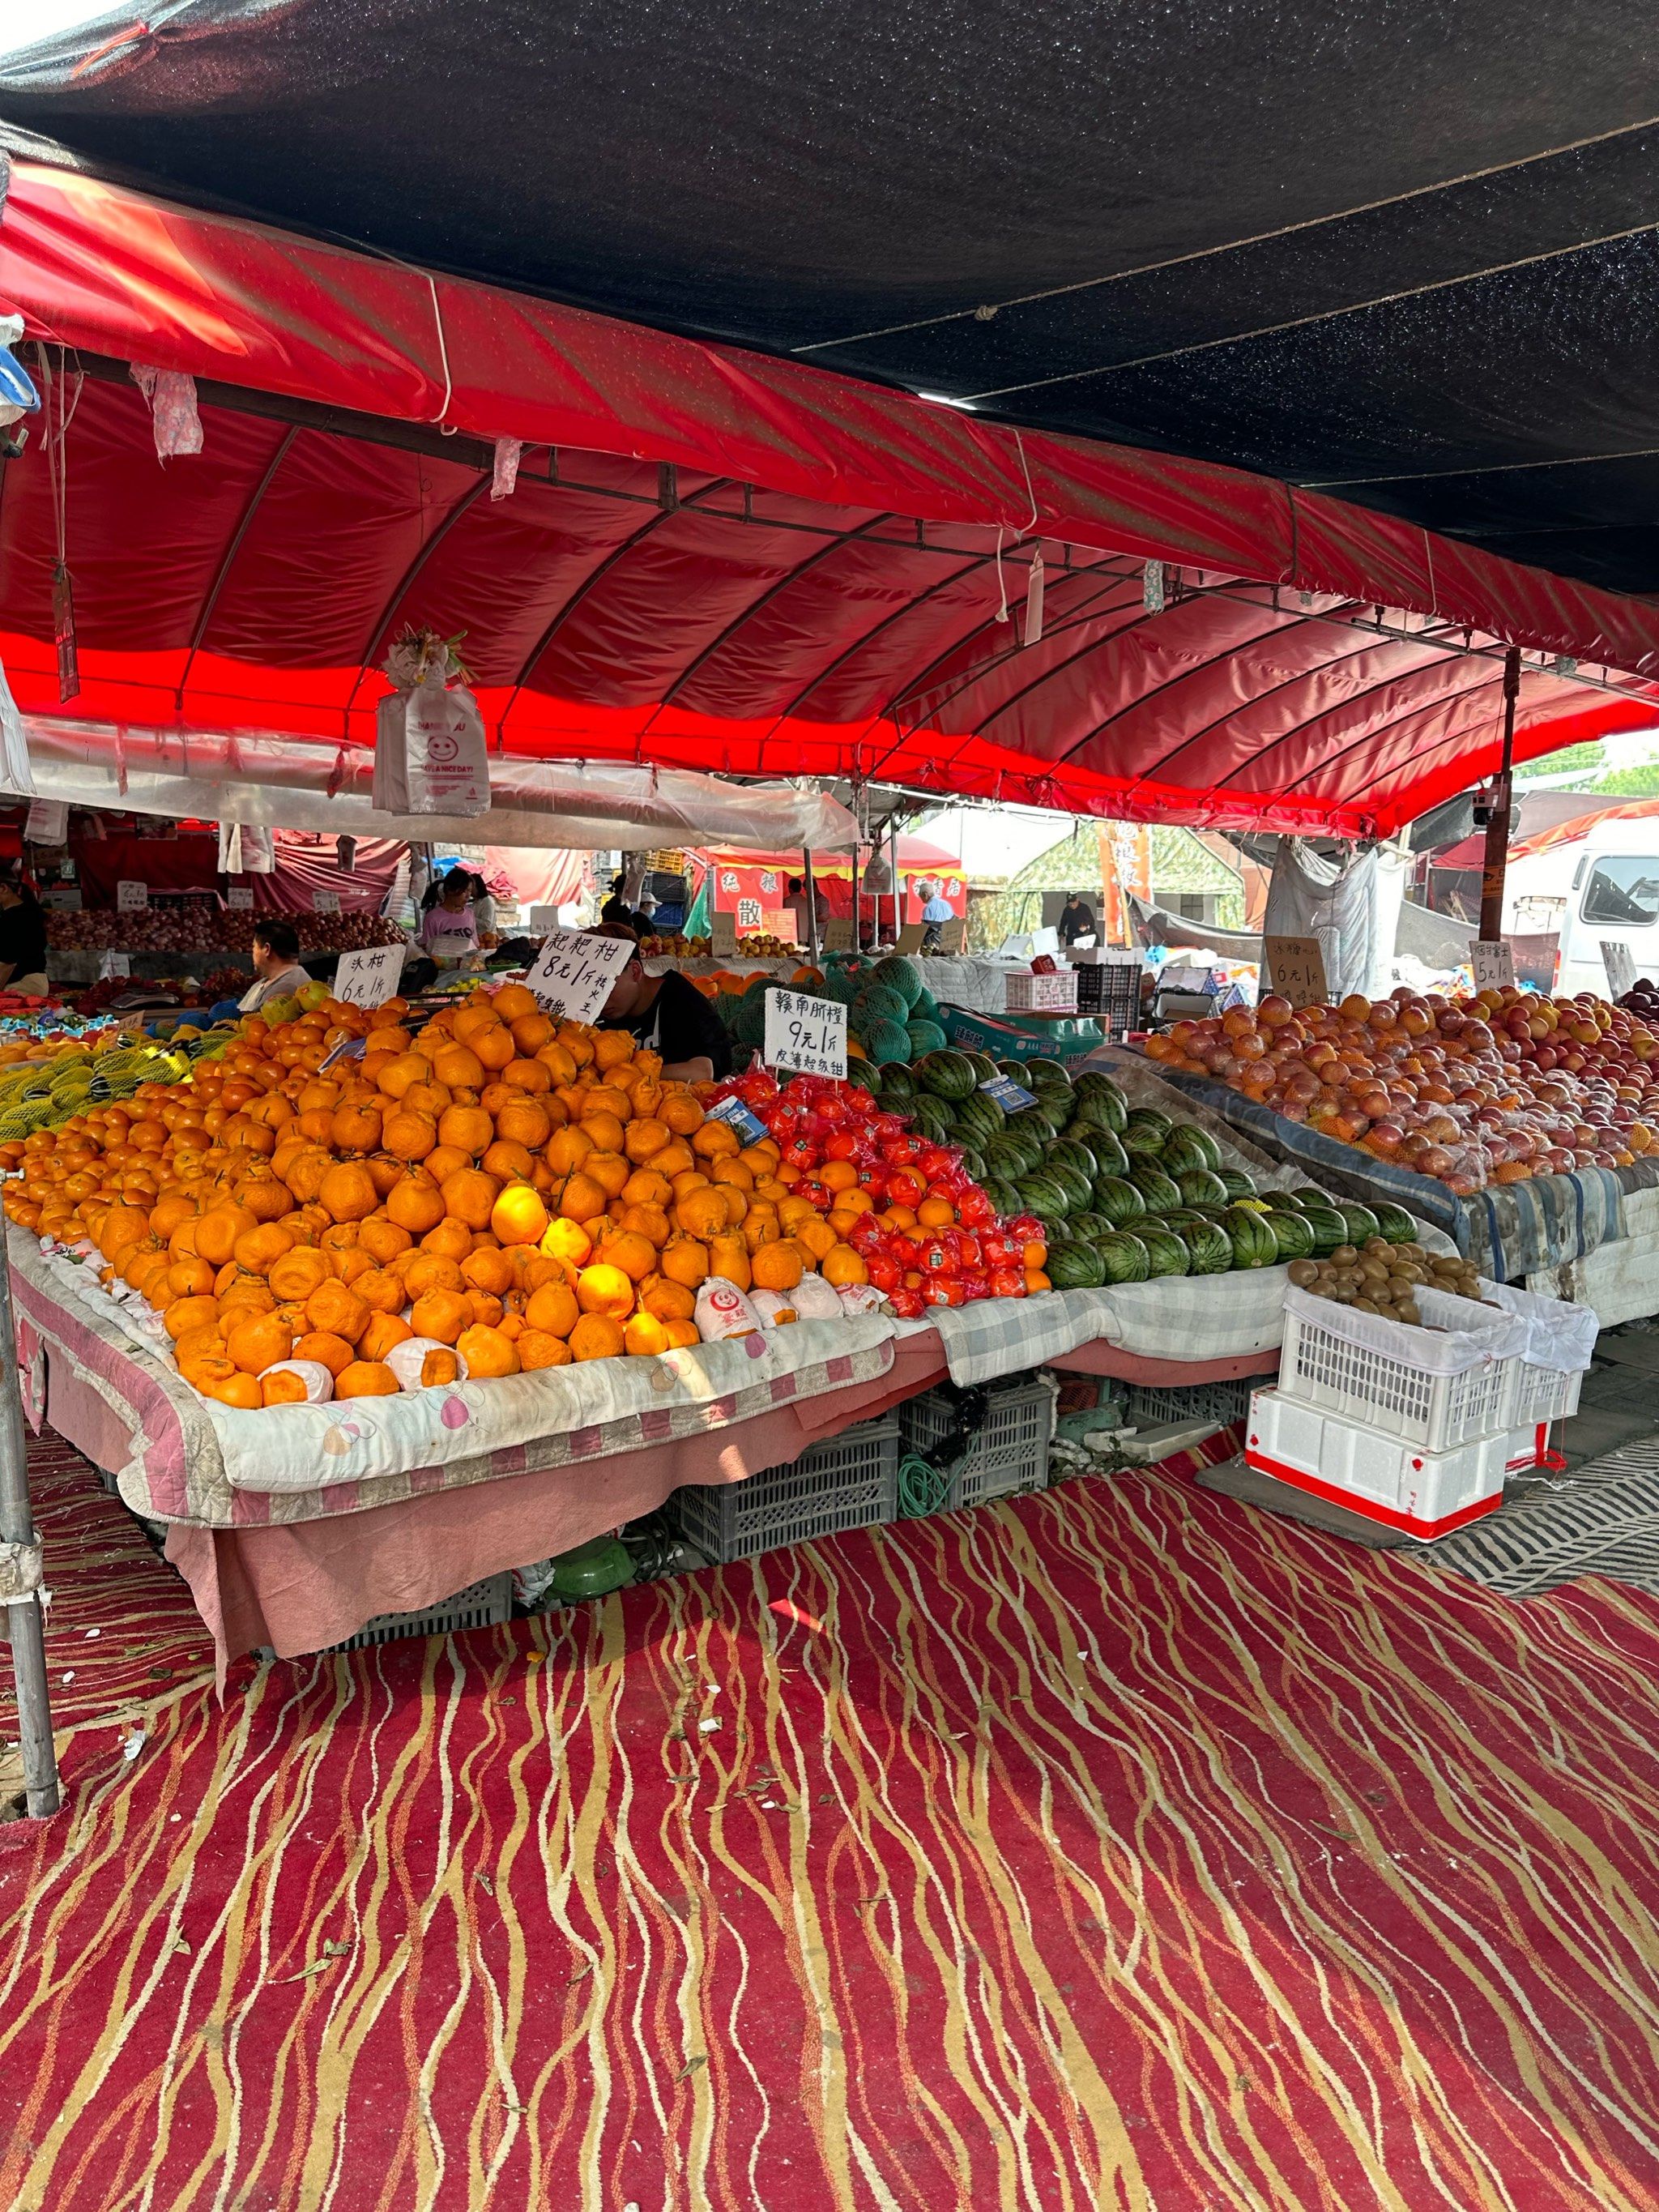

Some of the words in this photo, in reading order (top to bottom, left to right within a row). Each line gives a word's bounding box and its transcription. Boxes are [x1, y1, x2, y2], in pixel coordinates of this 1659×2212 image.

[739, 900, 761, 925] 散
[351, 953, 386, 972] 沃柑
[1277, 963, 1319, 986] 6元1斤
[1477, 961, 1508, 982] 5元1斤
[342, 976, 385, 1003] 6元1斤
[775, 990, 844, 1026] 赣南脐橙
[789, 1021, 838, 1053] 9元1斤
